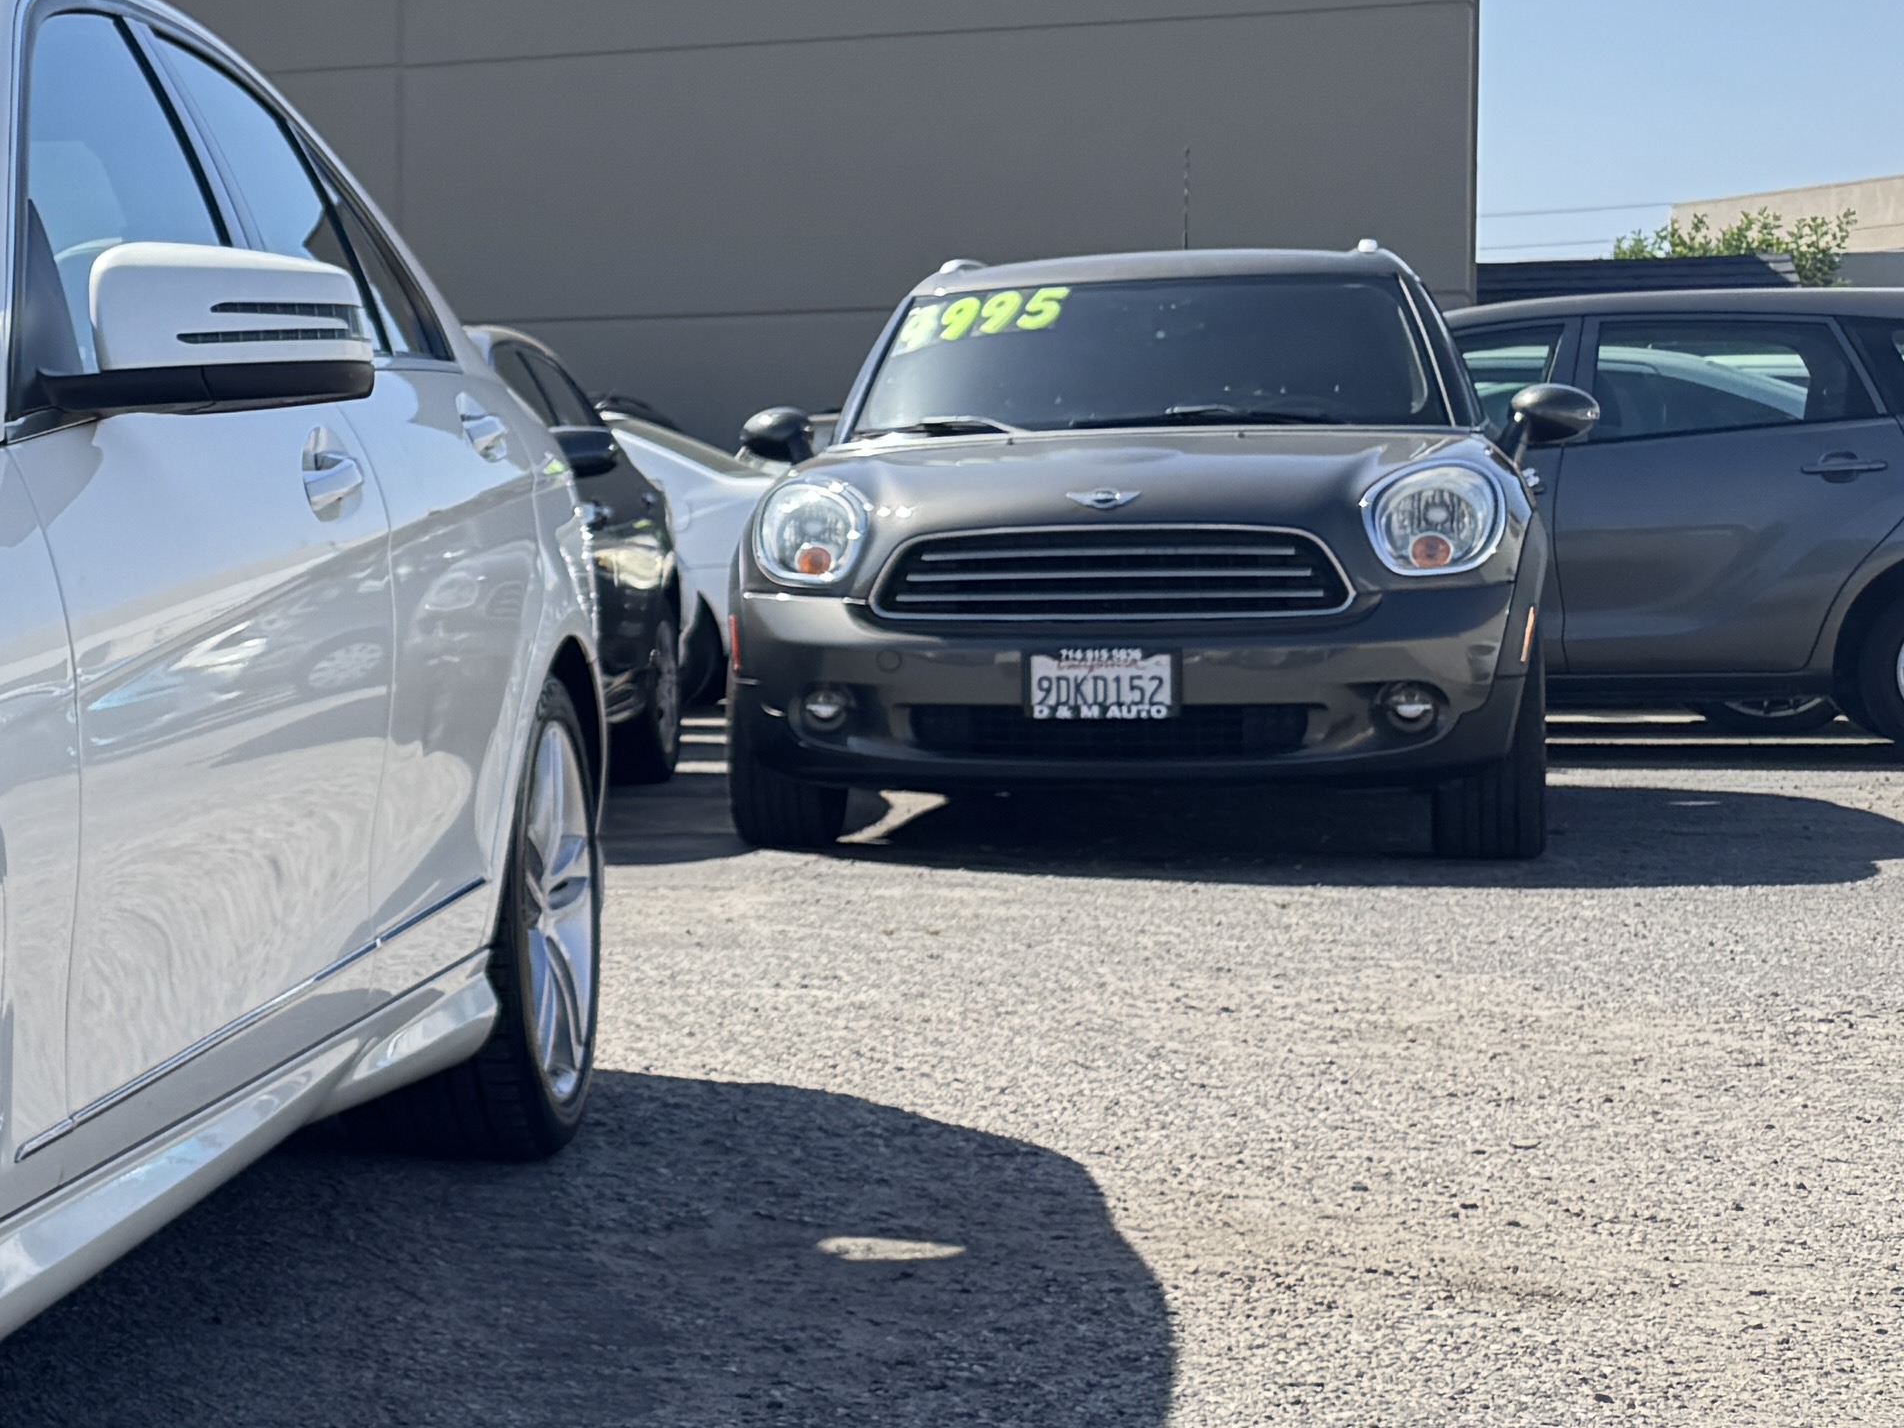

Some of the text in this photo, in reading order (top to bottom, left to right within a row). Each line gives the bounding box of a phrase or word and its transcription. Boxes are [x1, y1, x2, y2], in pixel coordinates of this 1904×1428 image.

[1037, 675, 1170, 706] 9DKD152
[1033, 704, 1168, 719] D & M AUTO
